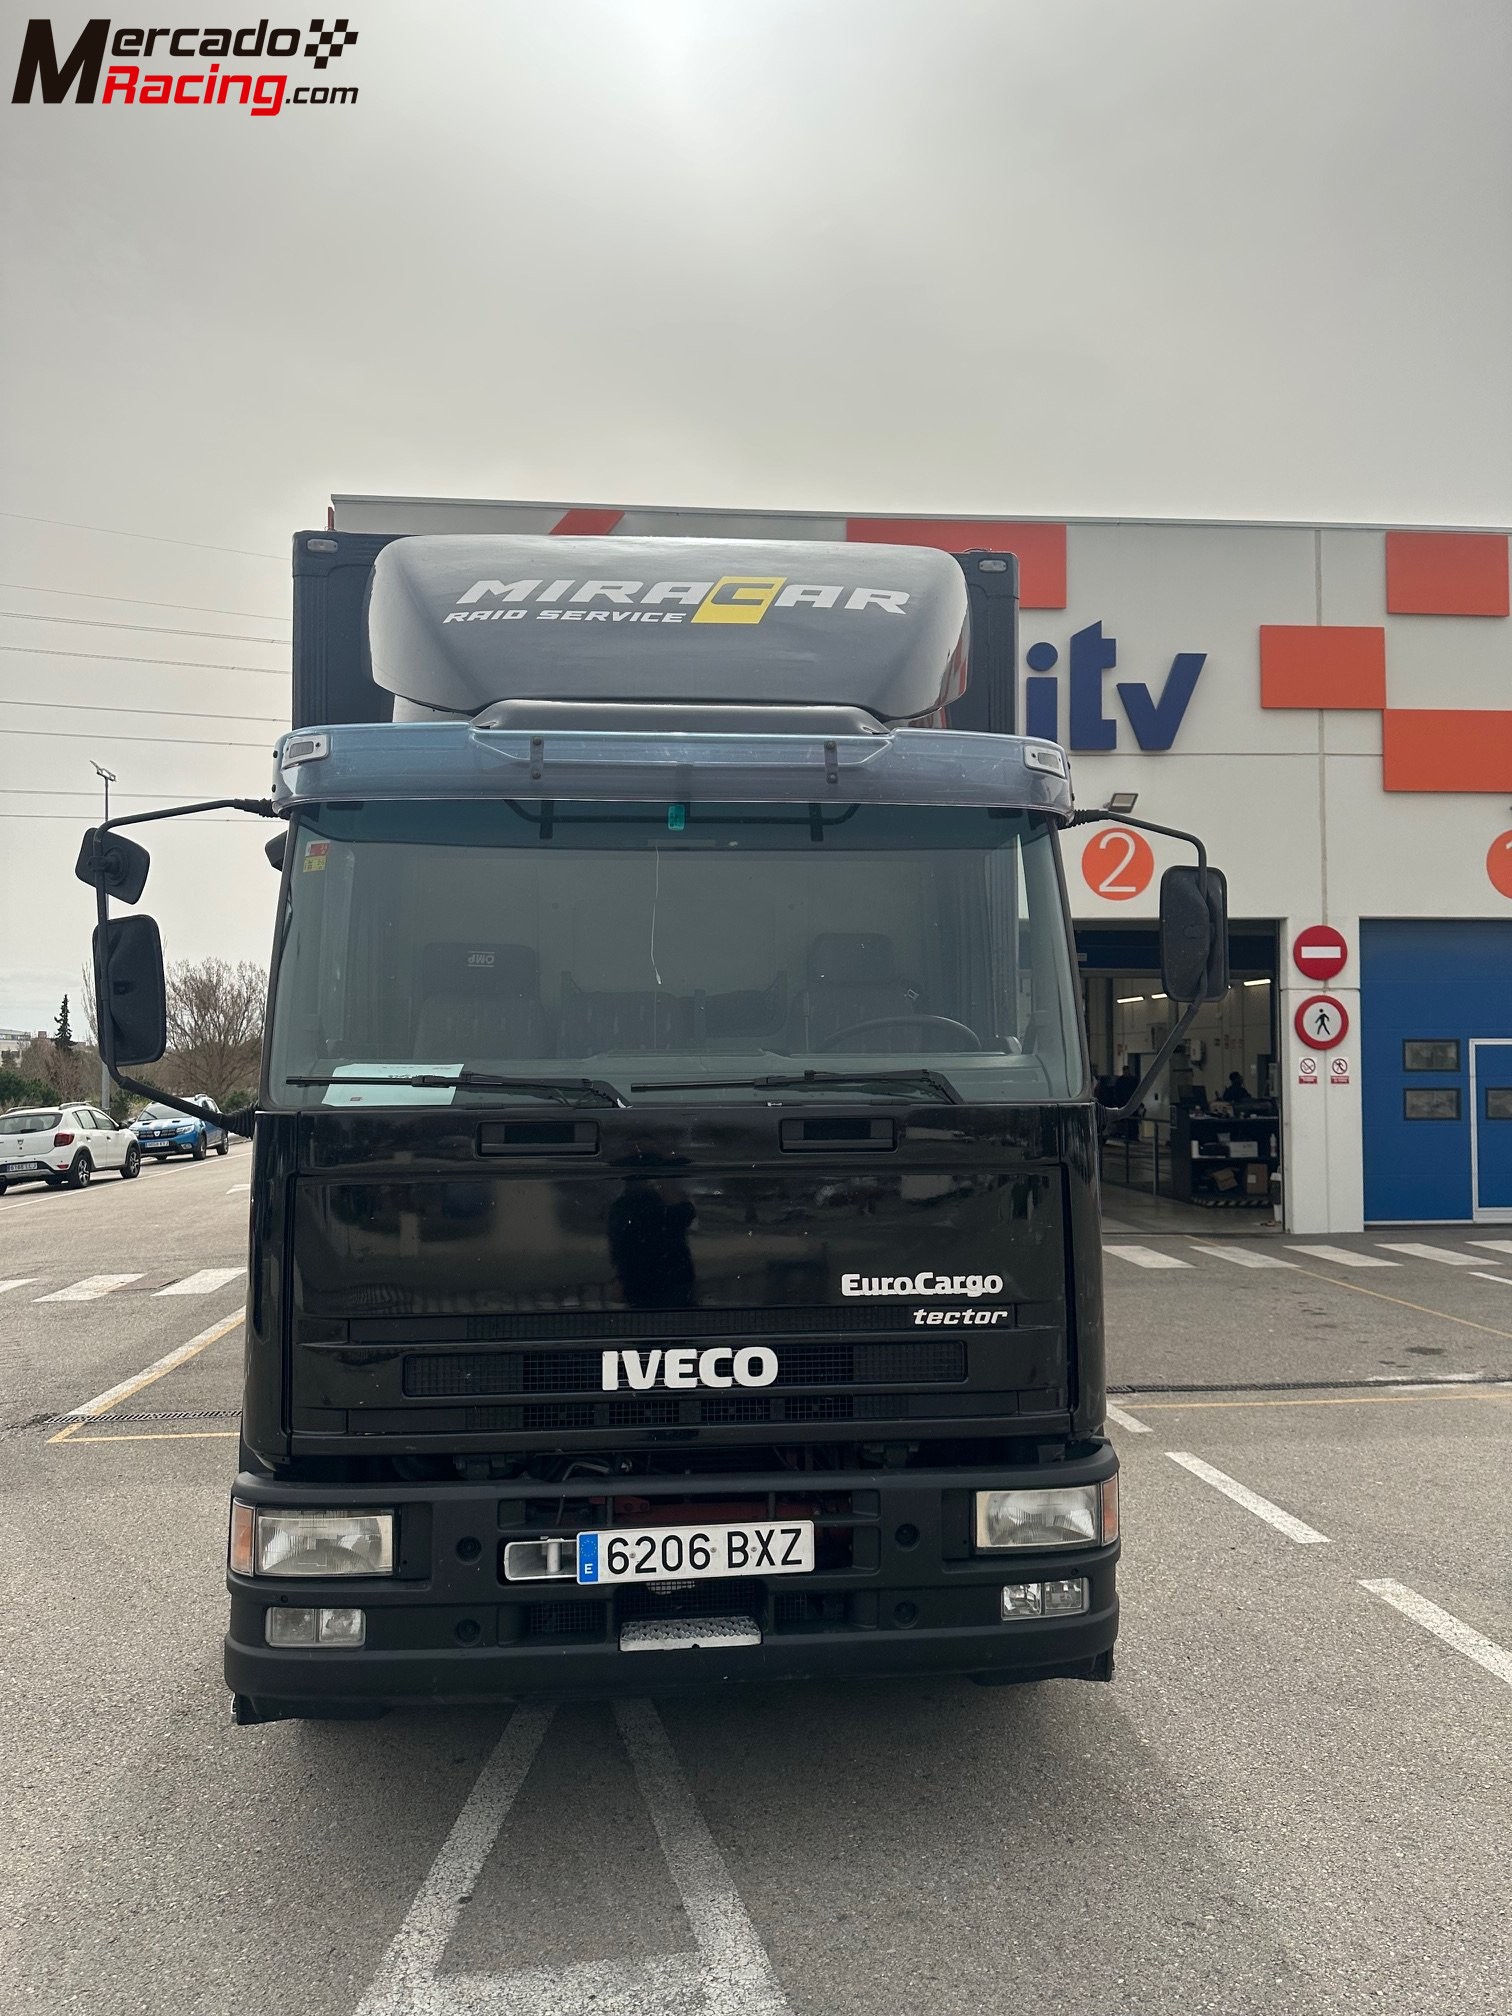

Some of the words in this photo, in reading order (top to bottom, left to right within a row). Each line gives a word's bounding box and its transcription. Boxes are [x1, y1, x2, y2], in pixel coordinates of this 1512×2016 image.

[443, 609, 528, 625] RAID
[536, 609, 687, 624] SERVICE
[456, 578, 911, 615] MIRACAR
[1026, 620, 1208, 751] itv
[1099, 831, 1137, 893] 2
[841, 1271, 1004, 1298] EuroCargo
[913, 1308, 1008, 1326] tector
[602, 1346, 779, 1391] IVECO
[584, 1563, 594, 1575] E
[607, 1533, 711, 1575] 6206
[727, 1528, 803, 1569] BXZ
